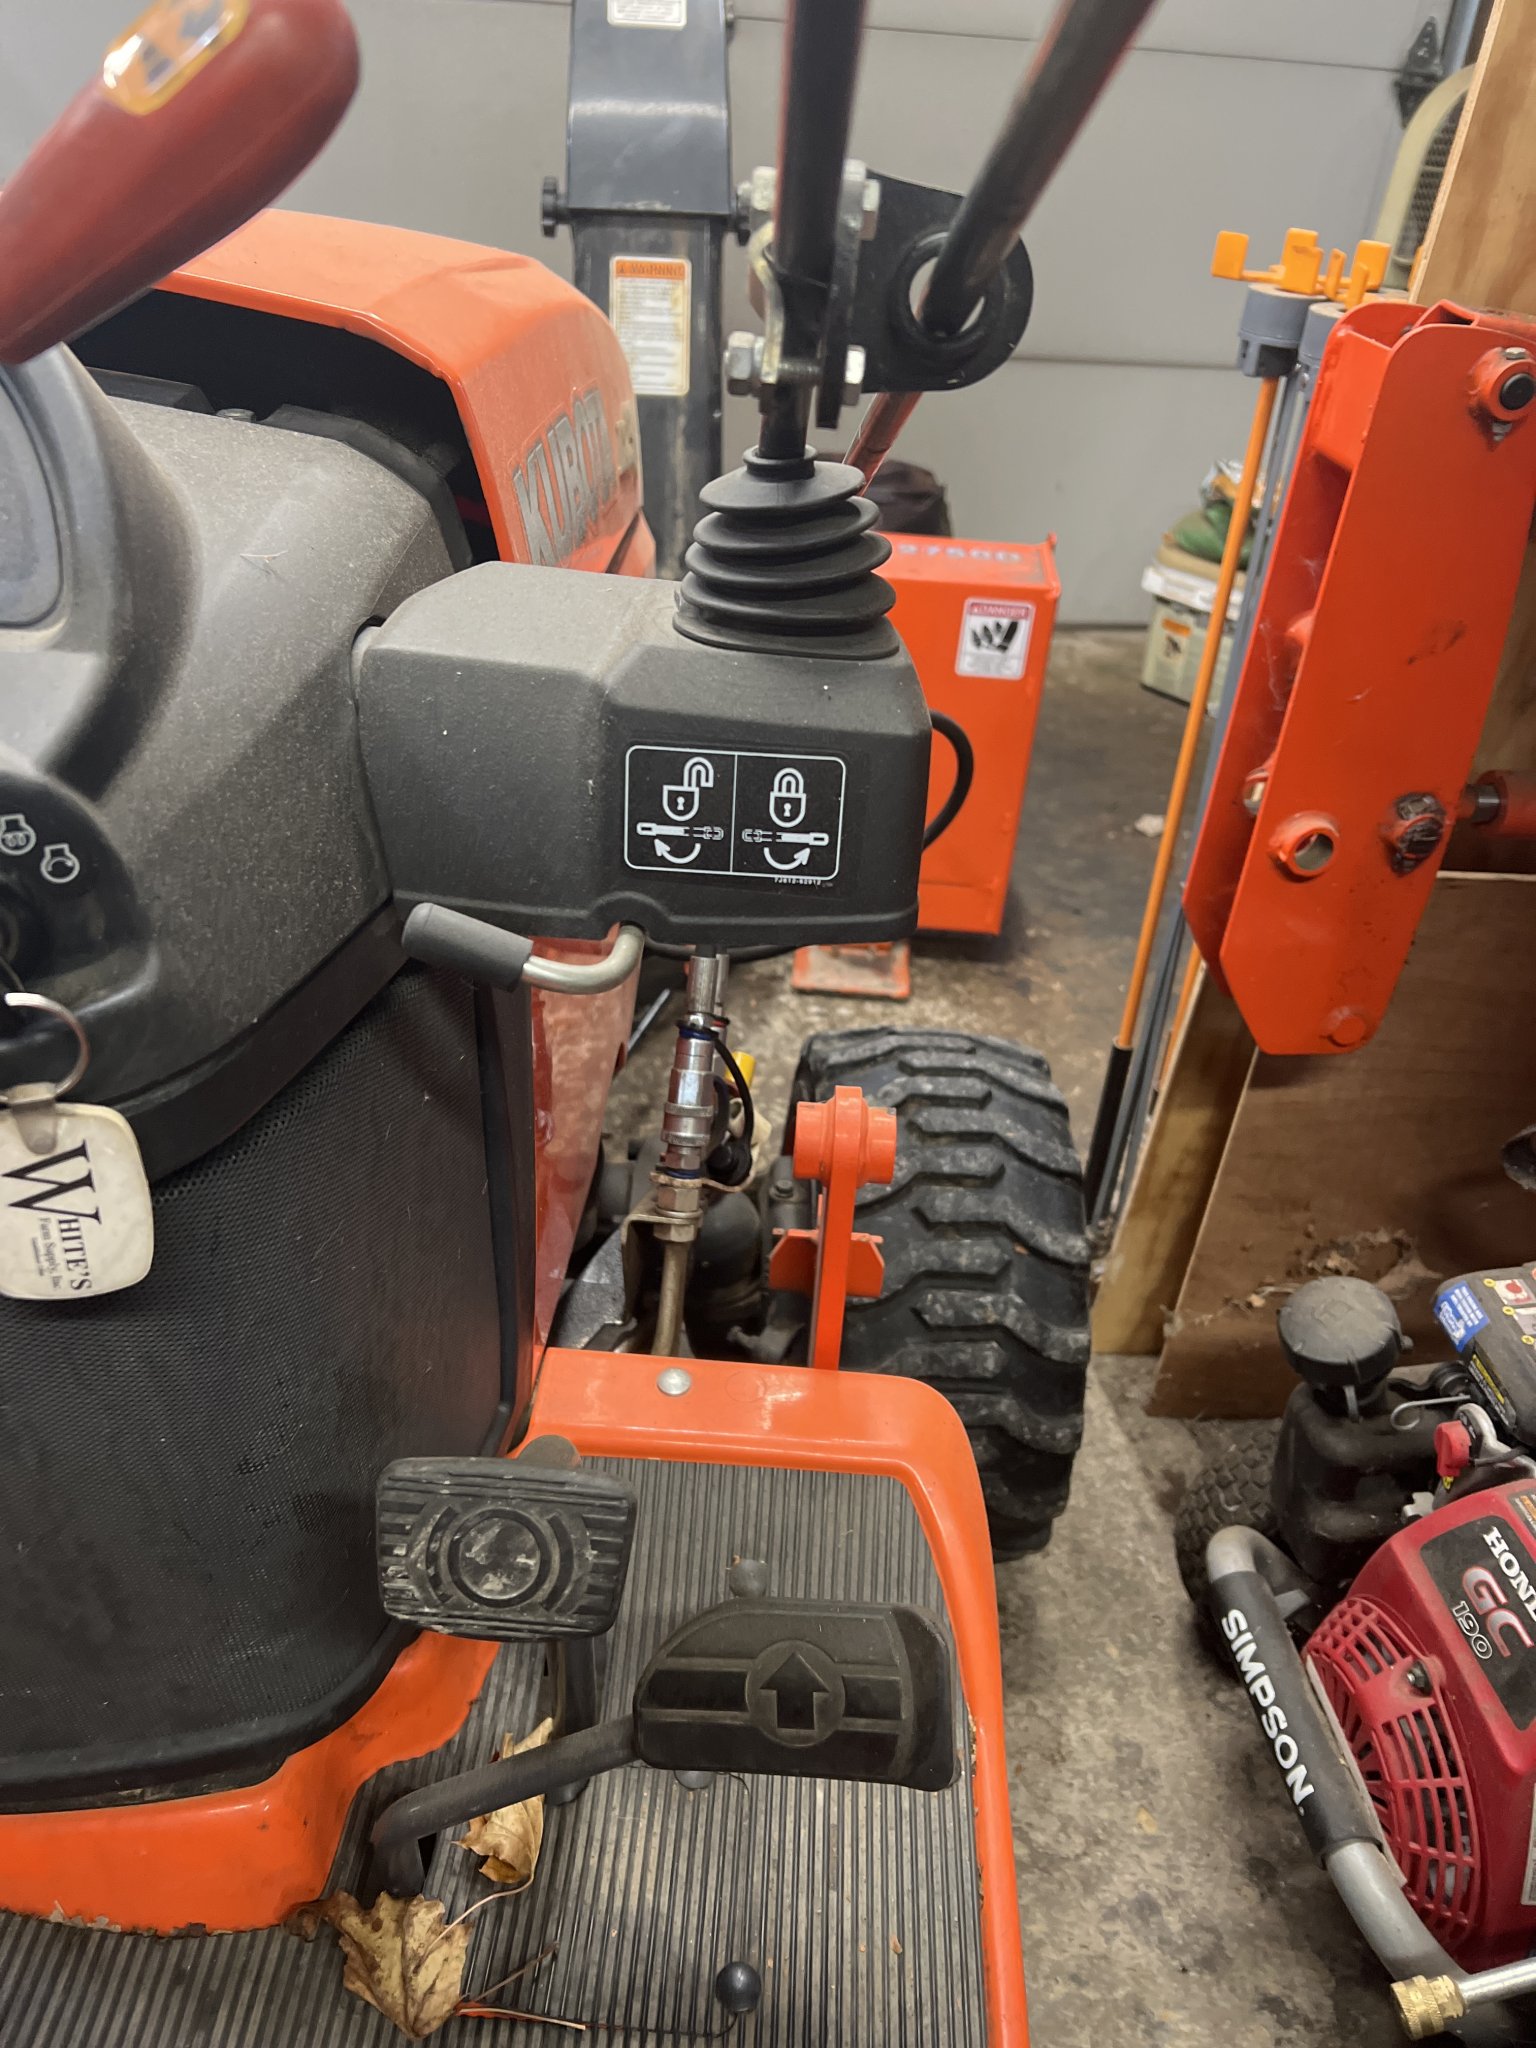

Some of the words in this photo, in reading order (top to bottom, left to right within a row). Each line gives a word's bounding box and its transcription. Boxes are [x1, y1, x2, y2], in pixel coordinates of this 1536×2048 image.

[39, 1217, 51, 1240] Farm
[1452, 1600, 1493, 1660] 190
[1462, 1565, 1535, 1658] GC
[1221, 1609, 1315, 1806] SIMPSON
